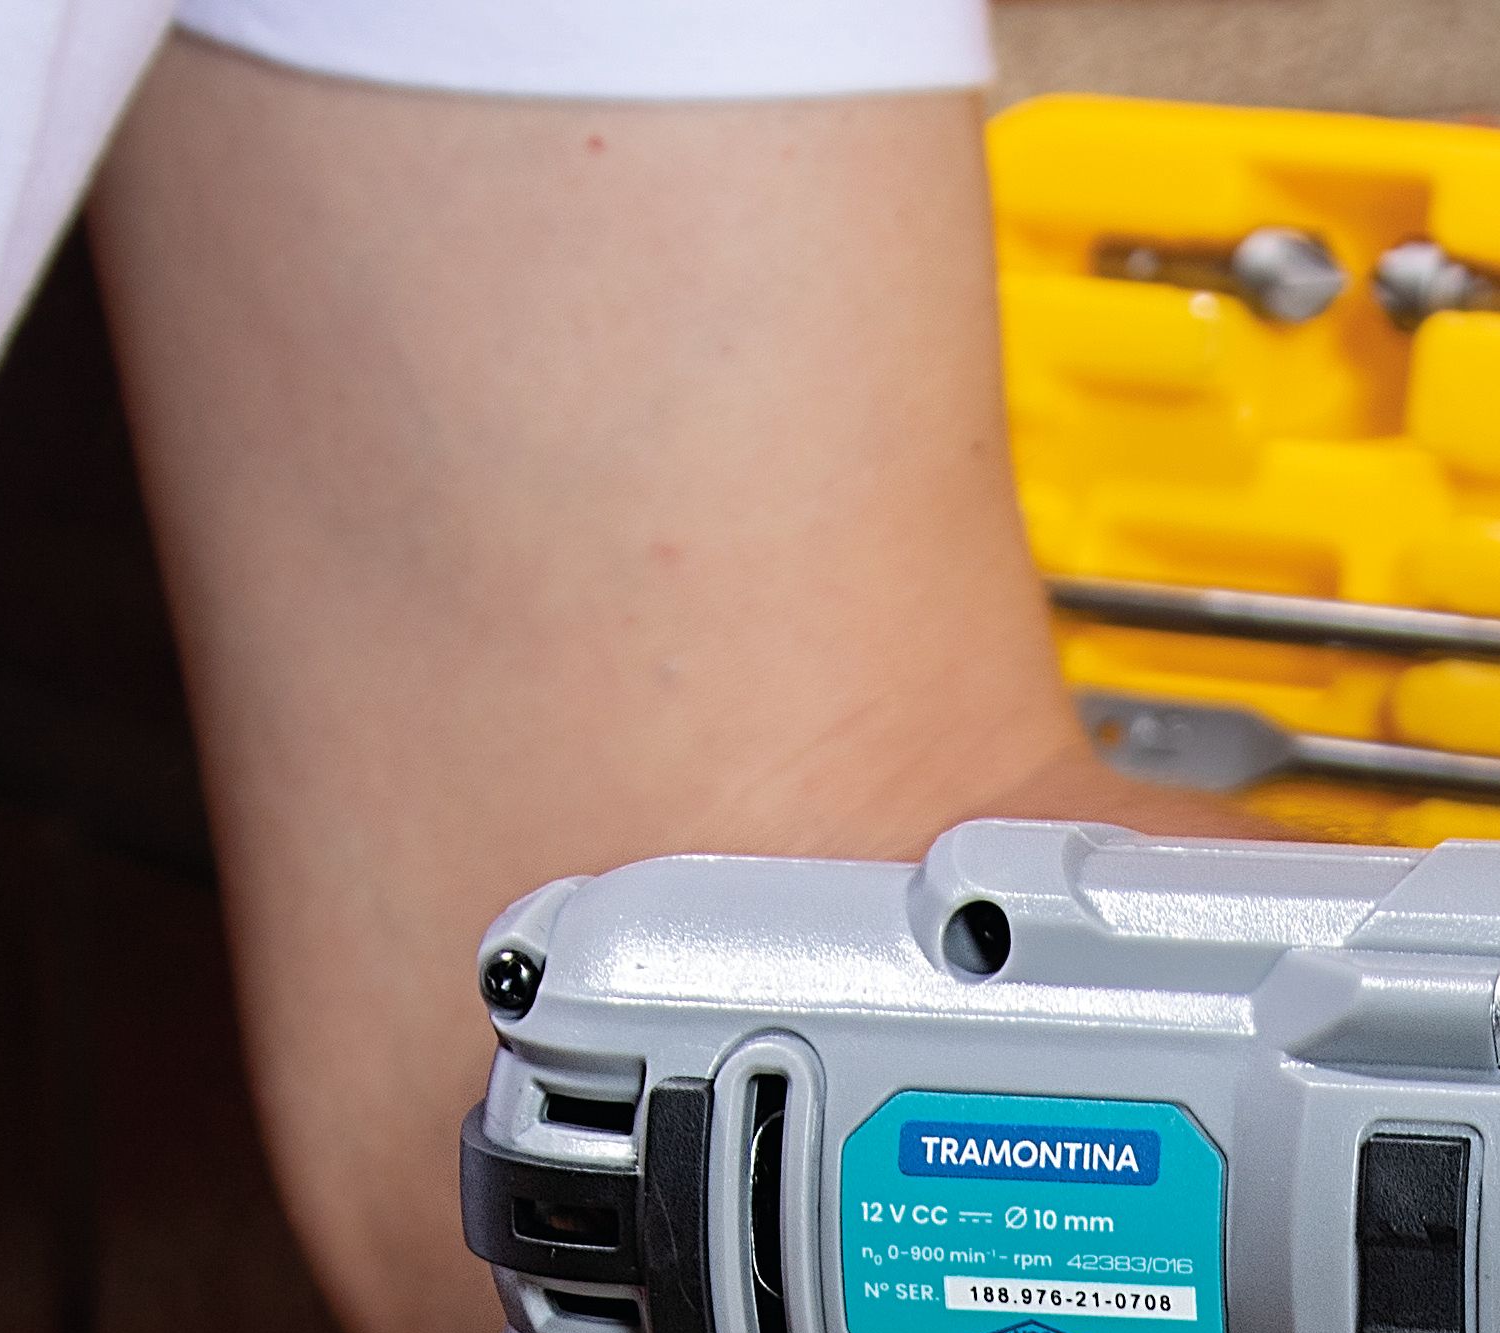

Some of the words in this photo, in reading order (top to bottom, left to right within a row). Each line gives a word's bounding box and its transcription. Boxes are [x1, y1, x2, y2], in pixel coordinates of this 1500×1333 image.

[921, 1136, 1140, 1173] TRAMONTINA
[861, 1201, 883, 1223] 12
[889, 1203, 906, 1223] V
[911, 1205, 948, 1225] CC
[1034, 1209, 1058, 1230] 10
[1064, 1214, 1115, 1233] mm
[887, 1245, 945, 1263] 0-900
[1013, 1253, 1052, 1270] rpm
[1066, 1253, 1194, 1275] 42383/016
[895, 1283, 940, 1301] SER.
[970, 1286, 1172, 1312] 188.976-21-0708
